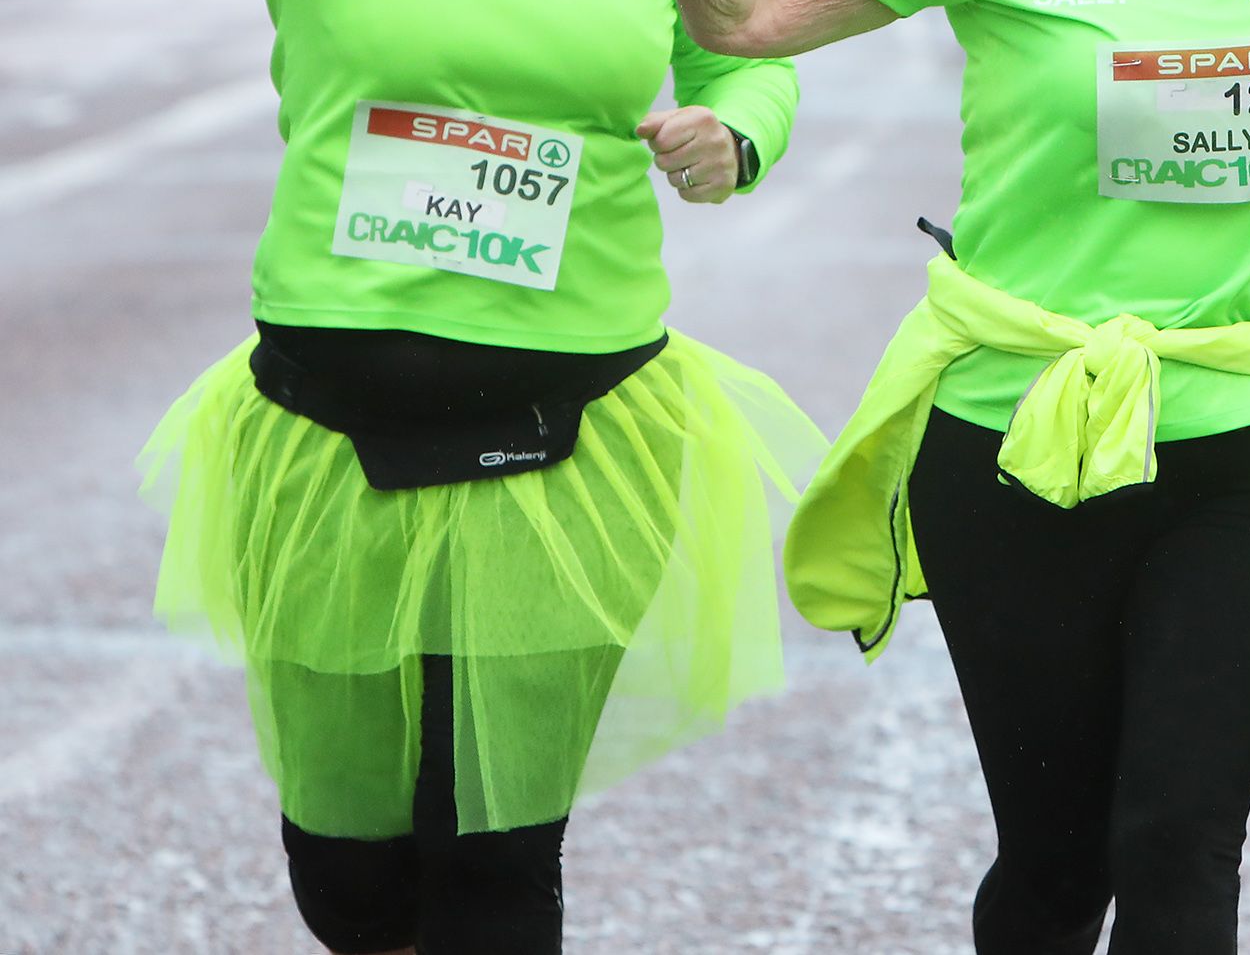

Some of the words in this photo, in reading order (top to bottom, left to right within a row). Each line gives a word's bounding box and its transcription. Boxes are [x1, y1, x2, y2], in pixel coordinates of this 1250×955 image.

[411, 117, 529, 156] SPAR
[470, 159, 569, 206] 1057
[425, 195, 482, 223] KAY
